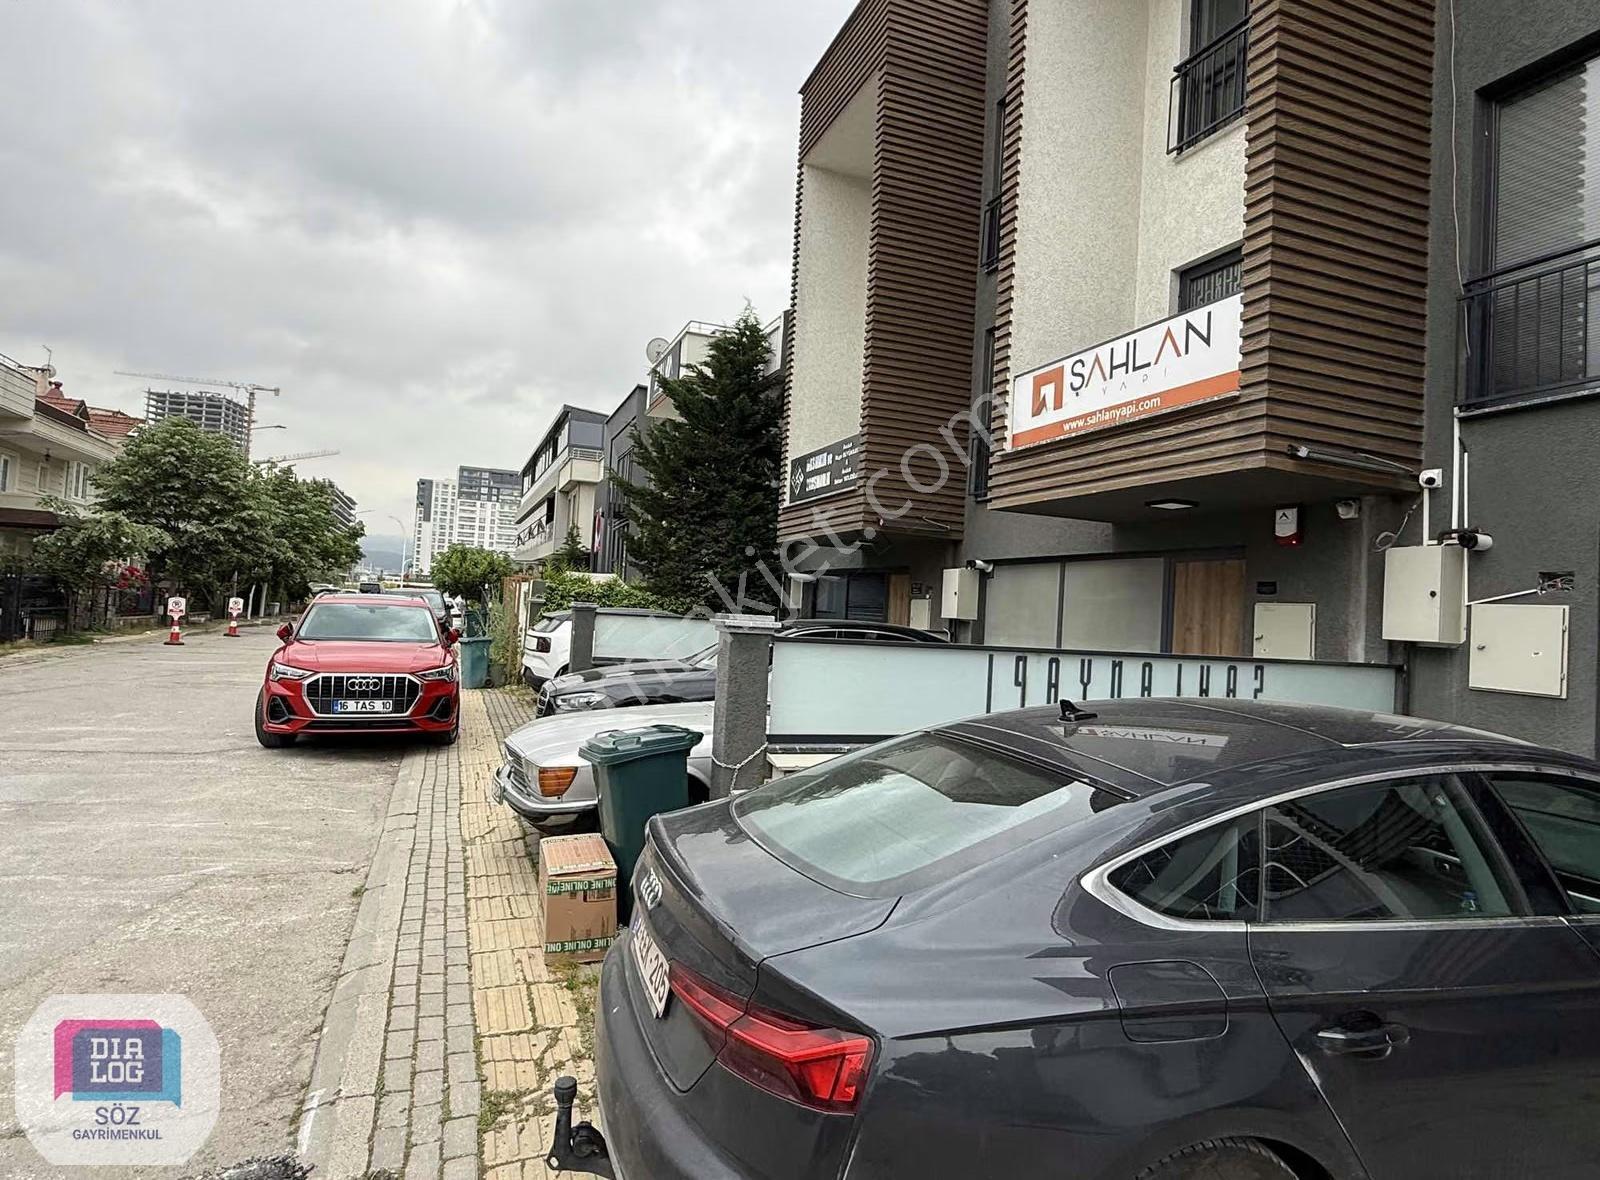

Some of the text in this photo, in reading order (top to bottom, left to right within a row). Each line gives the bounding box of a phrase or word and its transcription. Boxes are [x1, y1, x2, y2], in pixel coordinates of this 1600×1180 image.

[1070, 310, 1213, 398] ŞAHLAN
[1102, 369, 1168, 395] YAPI
[1062, 396, 1161, 432] www.sahlanyapi.com
[339, 701, 391, 711] 16 TAS 10
[560, 881, 589, 892] ONLINE
[563, 939, 592, 951] ONLINE
